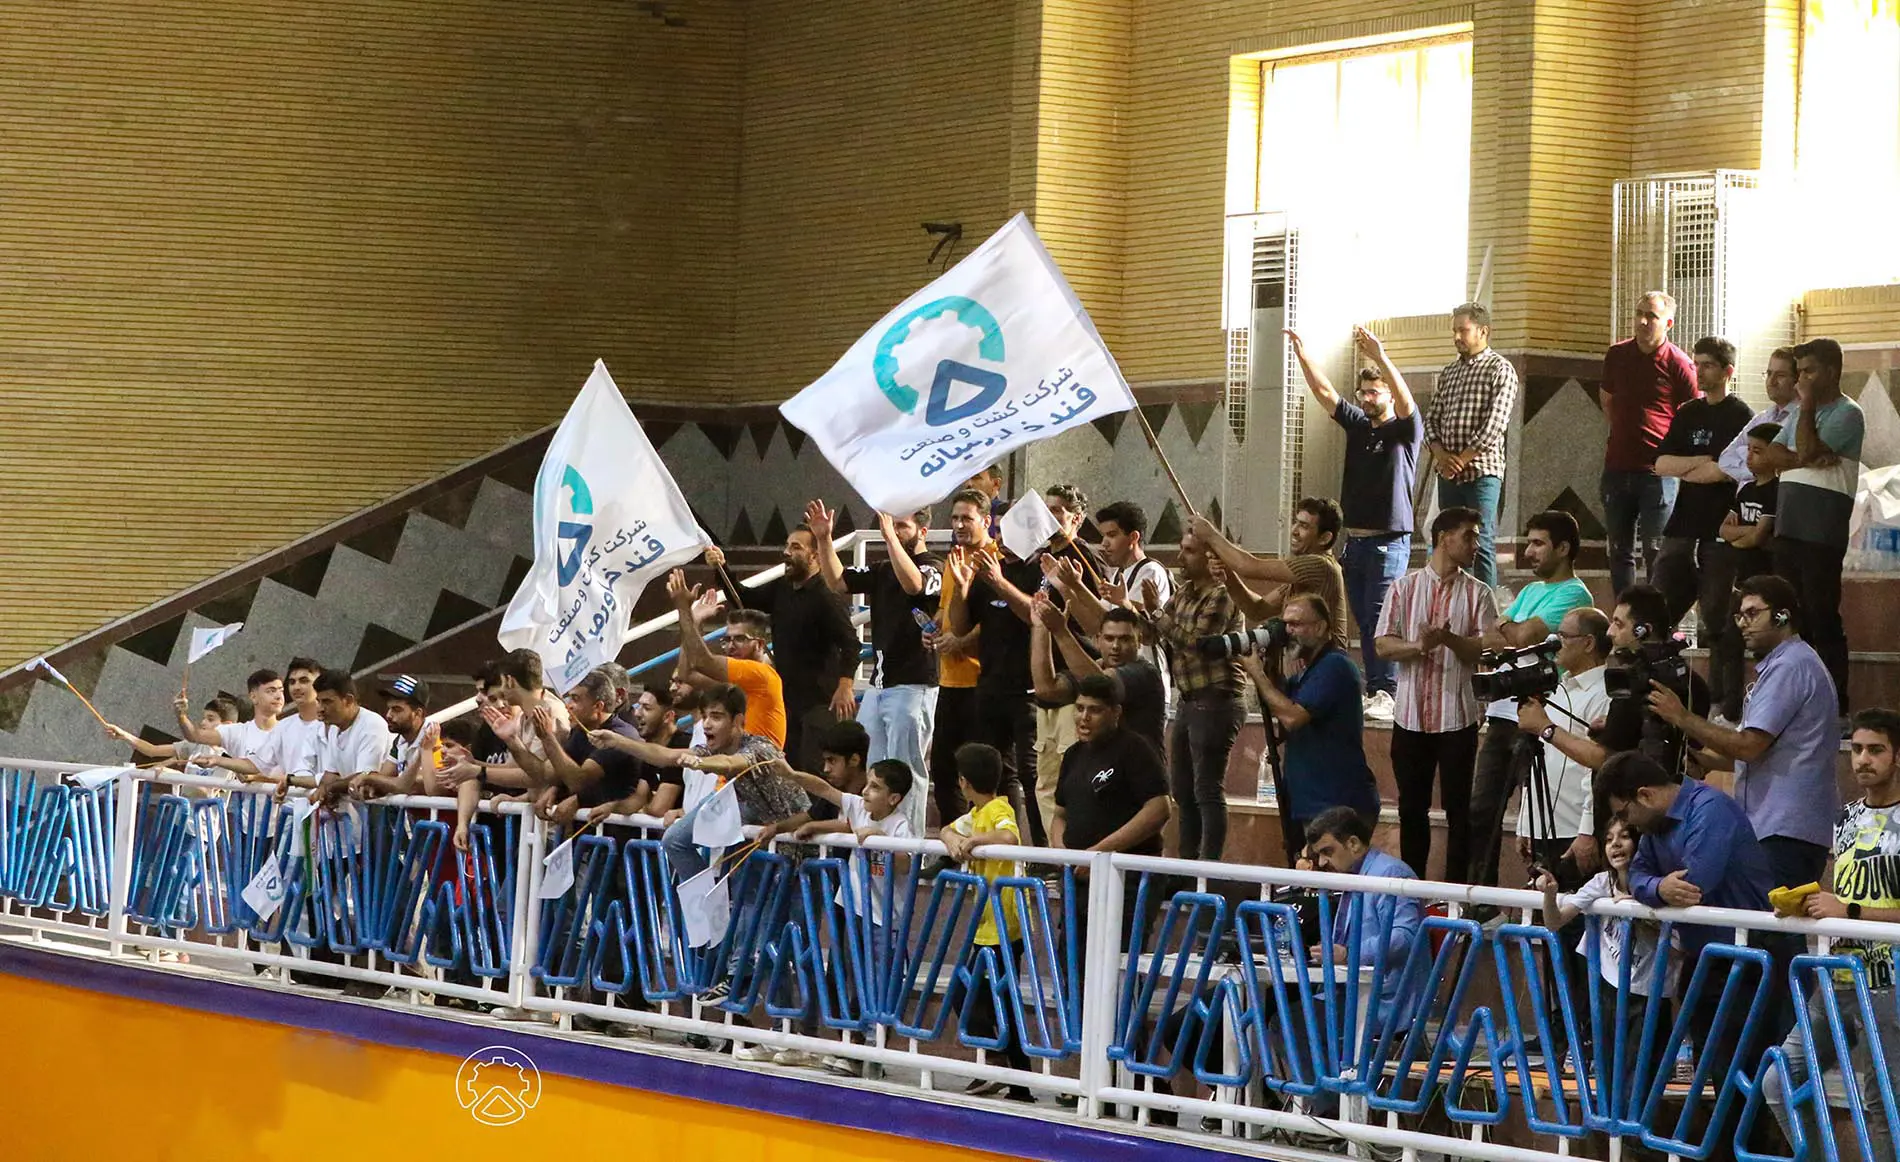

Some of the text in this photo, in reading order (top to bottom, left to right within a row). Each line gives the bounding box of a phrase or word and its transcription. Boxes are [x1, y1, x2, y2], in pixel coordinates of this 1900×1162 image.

[900, 367, 1074, 461] شرکت کشت و صنعت
[920, 382, 1098, 478] قند خارمیانه
[604, 519, 647, 554] شرکت
[625, 535, 666, 573] قند
[578, 589, 588, 601] و
[549, 599, 582, 644] صنعت
